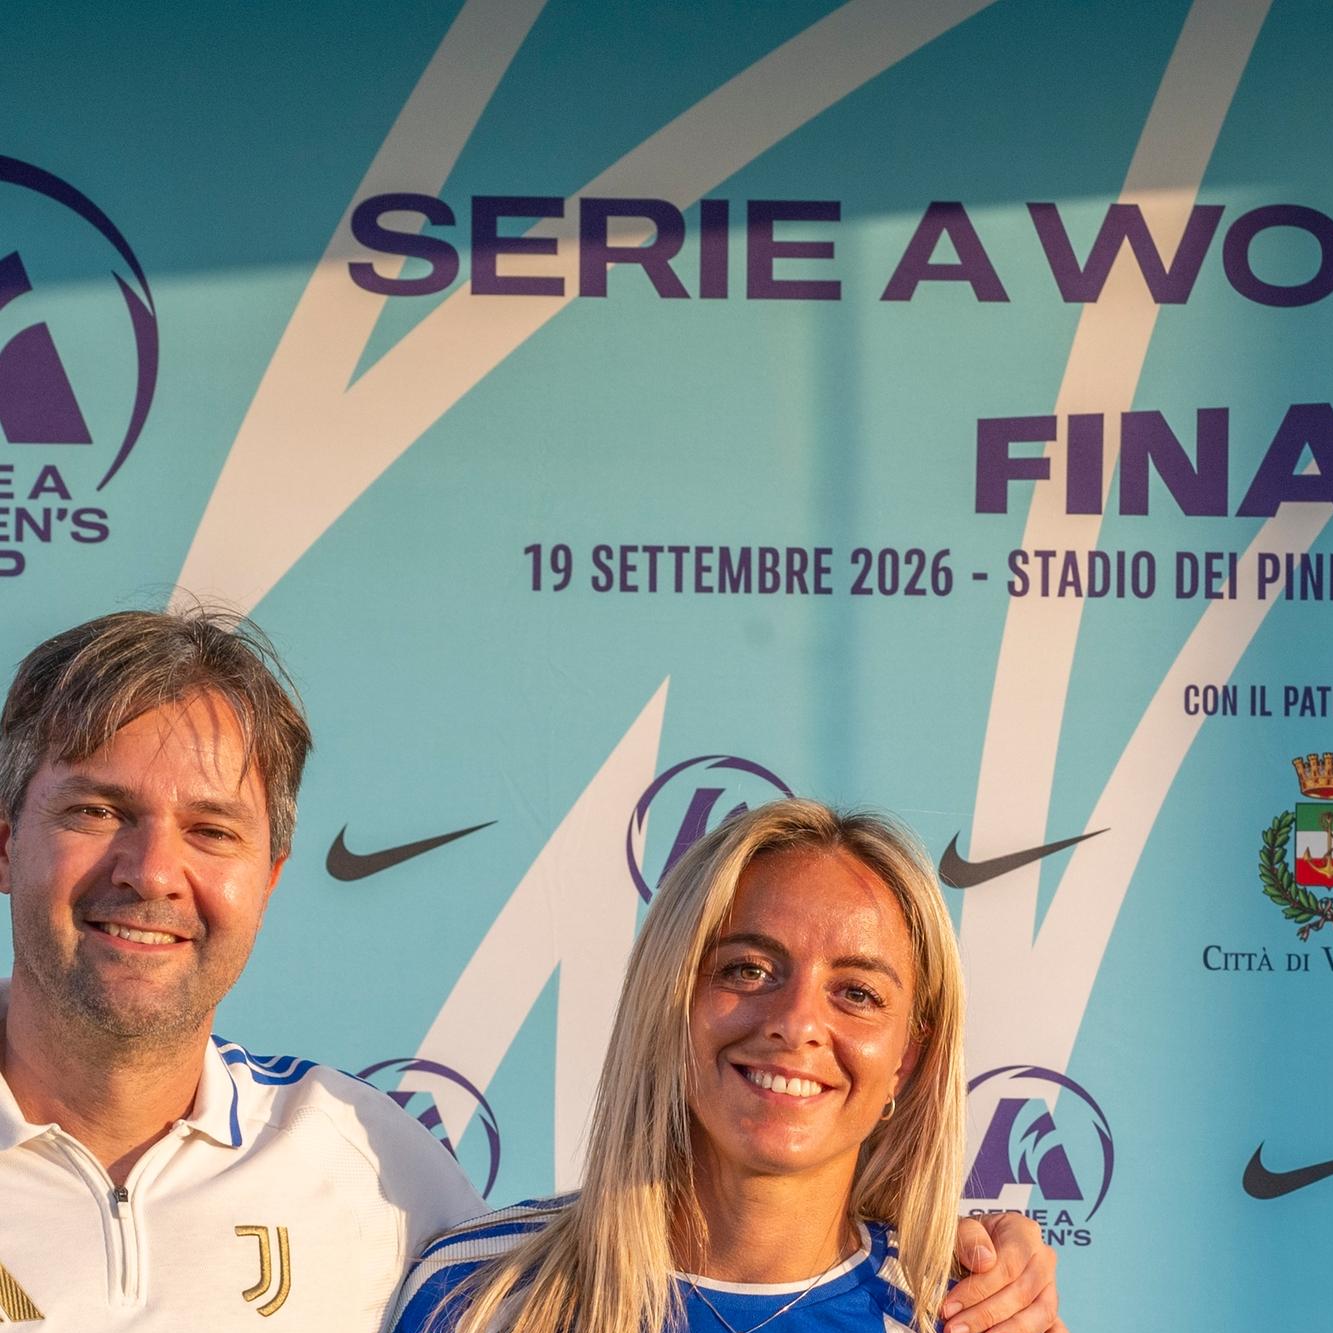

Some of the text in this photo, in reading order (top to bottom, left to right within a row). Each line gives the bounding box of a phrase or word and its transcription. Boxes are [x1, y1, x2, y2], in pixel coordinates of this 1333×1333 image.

[349, 193, 841, 300] SERIE
[880, 202, 1010, 302] A
[28, 465, 72, 500] A
[524, 543, 572, 592] 19
[592, 545, 832, 594] SETTEMBRE
[851, 548, 952, 597] 2026
[1008, 549, 1155, 600] STADIO
[1176, 552, 1237, 600] DEI
[1184, 684, 1237, 716] CON
[1250, 685, 1272, 717] IL
[1054, 1209, 1074, 1226] A
